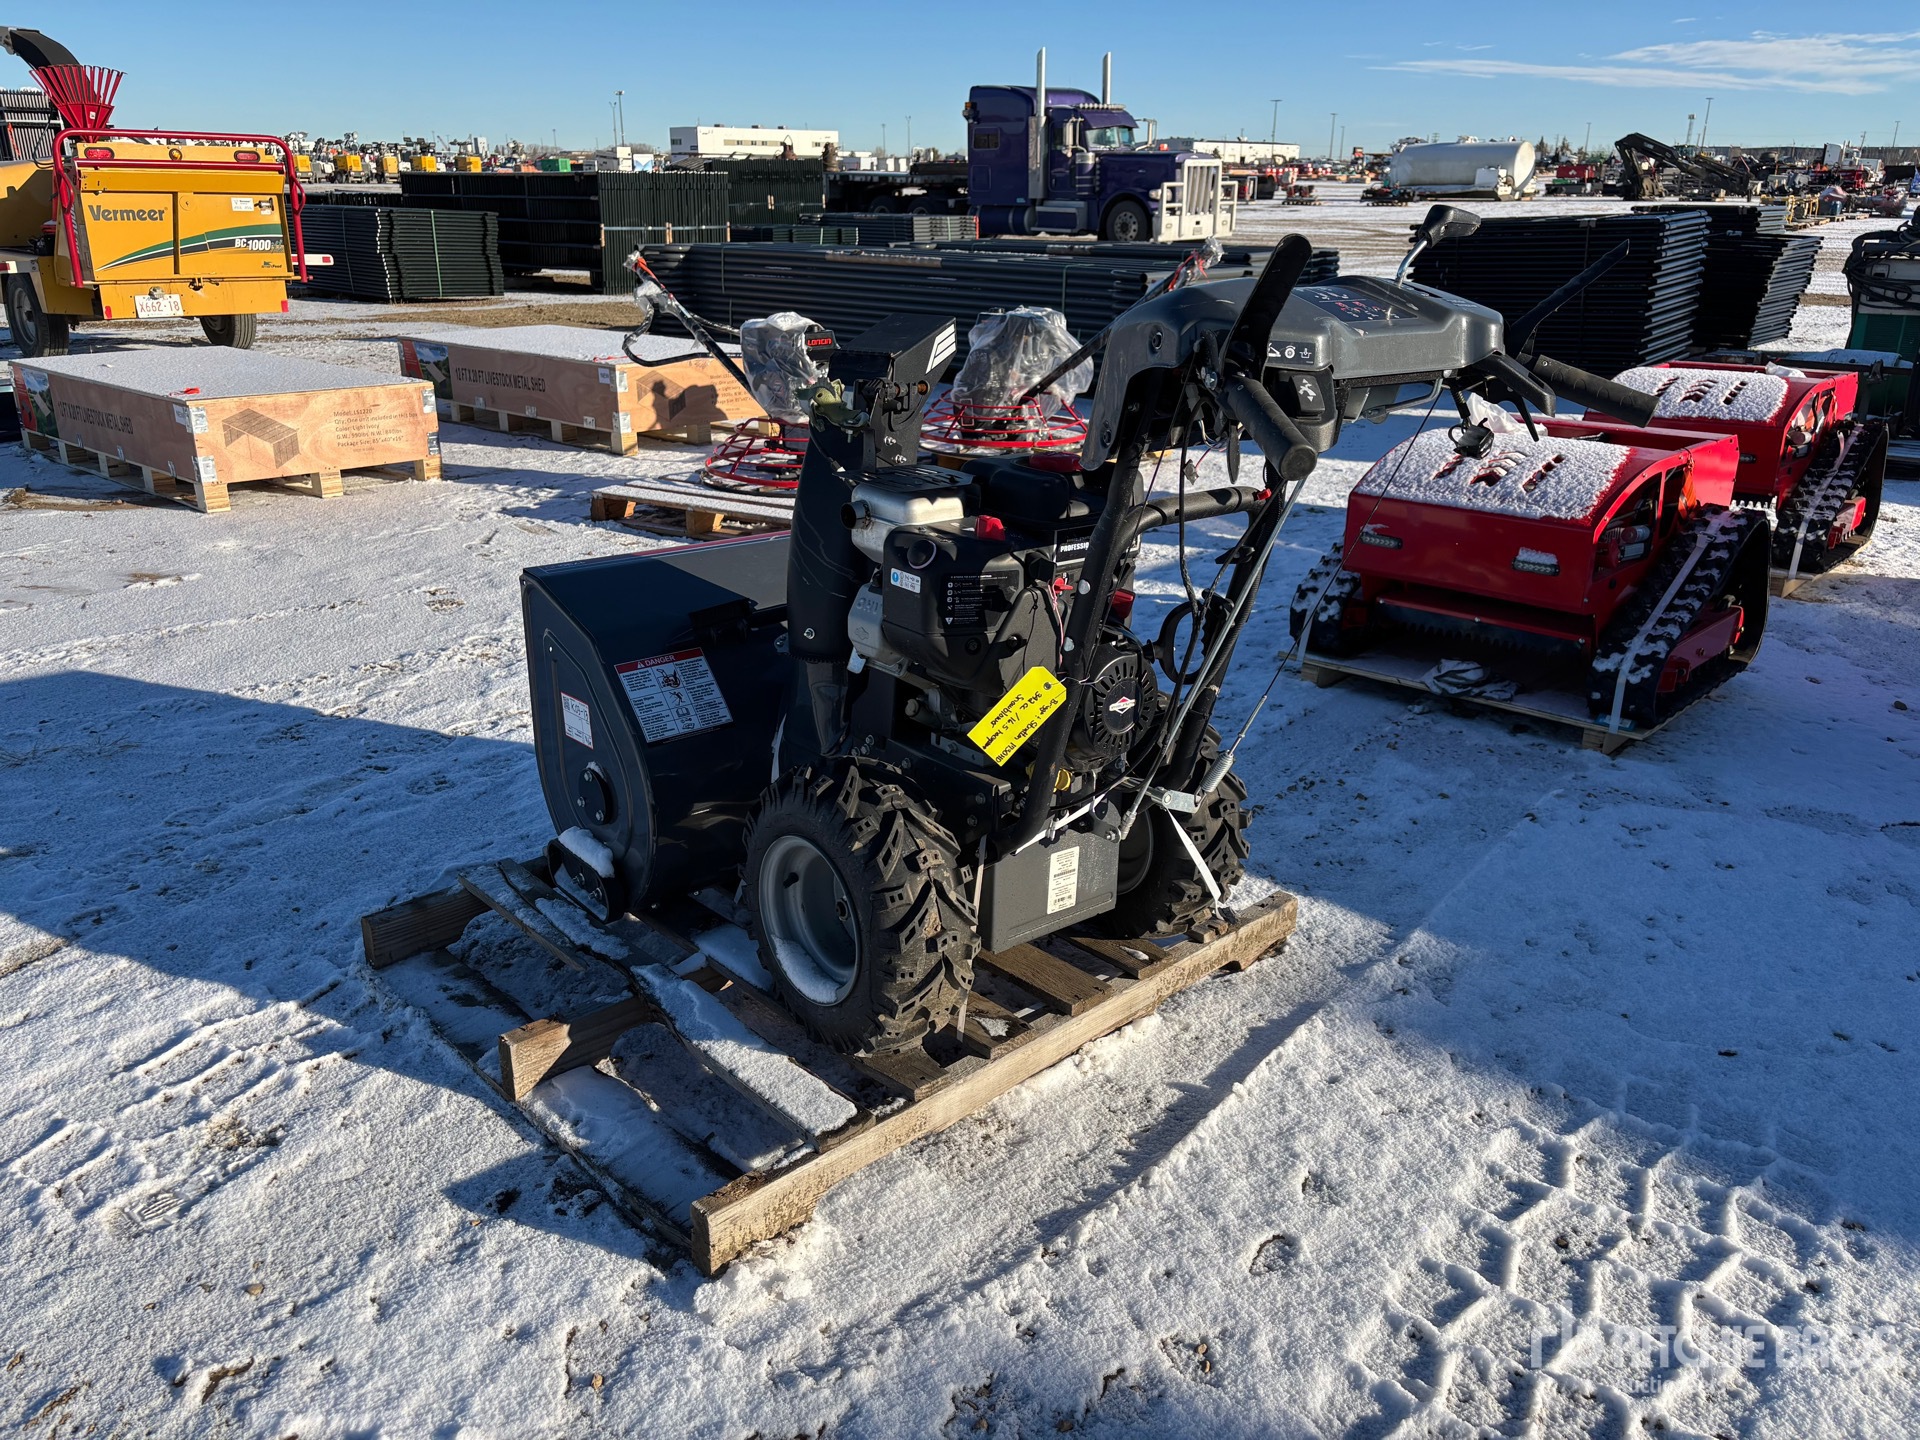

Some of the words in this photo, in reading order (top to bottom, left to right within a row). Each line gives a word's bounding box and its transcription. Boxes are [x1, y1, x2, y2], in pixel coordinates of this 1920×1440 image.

[88, 204, 165, 222] Vermeer
[235, 238, 247, 248] BC
[247, 239, 271, 251] 1000
[485, 371, 513, 389] LIVESTOCK
[513, 374, 531, 391] METAL
[531, 376, 546, 393] SHED
[82, 406, 105, 427] LIVESTOCK
[105, 411, 120, 431] METAL
[120, 415, 134, 435] SHED
[644, 654, 676, 667] DANGER
